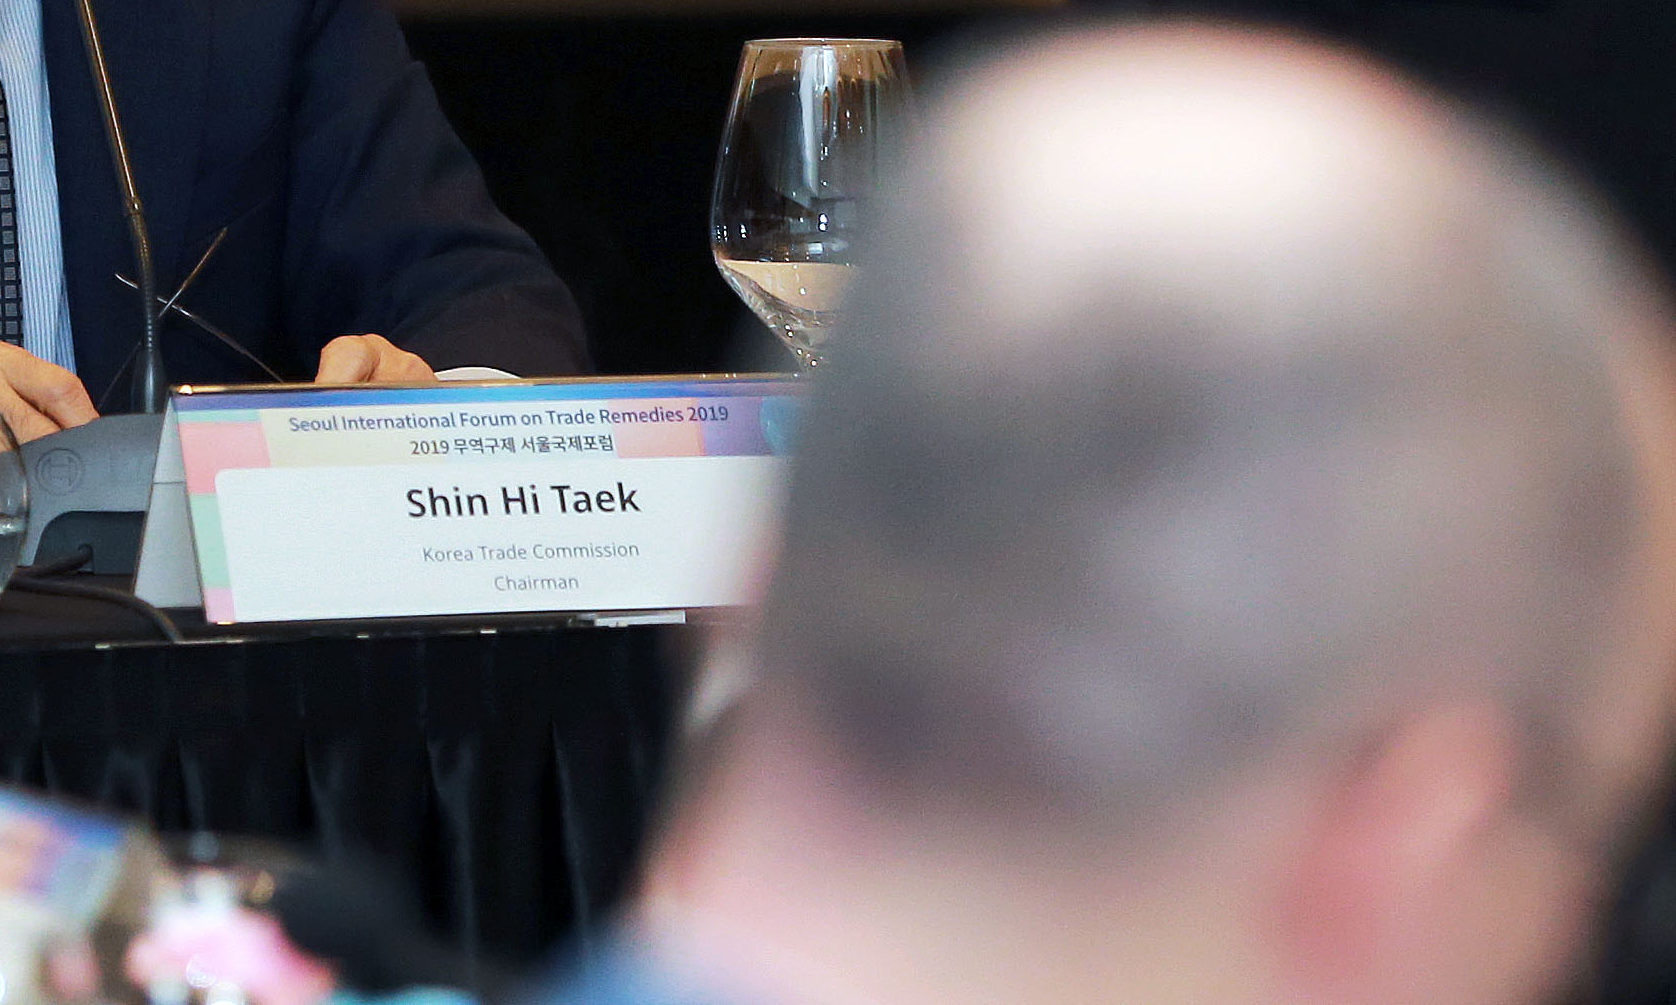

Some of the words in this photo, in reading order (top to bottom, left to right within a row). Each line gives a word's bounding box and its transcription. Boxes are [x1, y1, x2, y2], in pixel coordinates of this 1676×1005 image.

[288, 415, 337, 432] Seoul
[342, 412, 456, 431] International
[460, 412, 516, 427] Forum
[520, 413, 543, 426] on
[545, 409, 595, 425] Trade
[599, 406, 684, 424] Remedies
[687, 405, 729, 422] 2019
[410, 440, 450, 455] 2019
[453, 436, 516, 455] 무역구제
[520, 434, 614, 453] 서울국제포럼
[406, 486, 489, 518] Shin
[501, 484, 541, 515] Hi
[549, 482, 642, 514] Taek
[423, 547, 474, 563] Korea
[478, 543, 528, 561] Trade
[532, 542, 640, 560] Commission
[494, 575, 580, 592] Chairman
